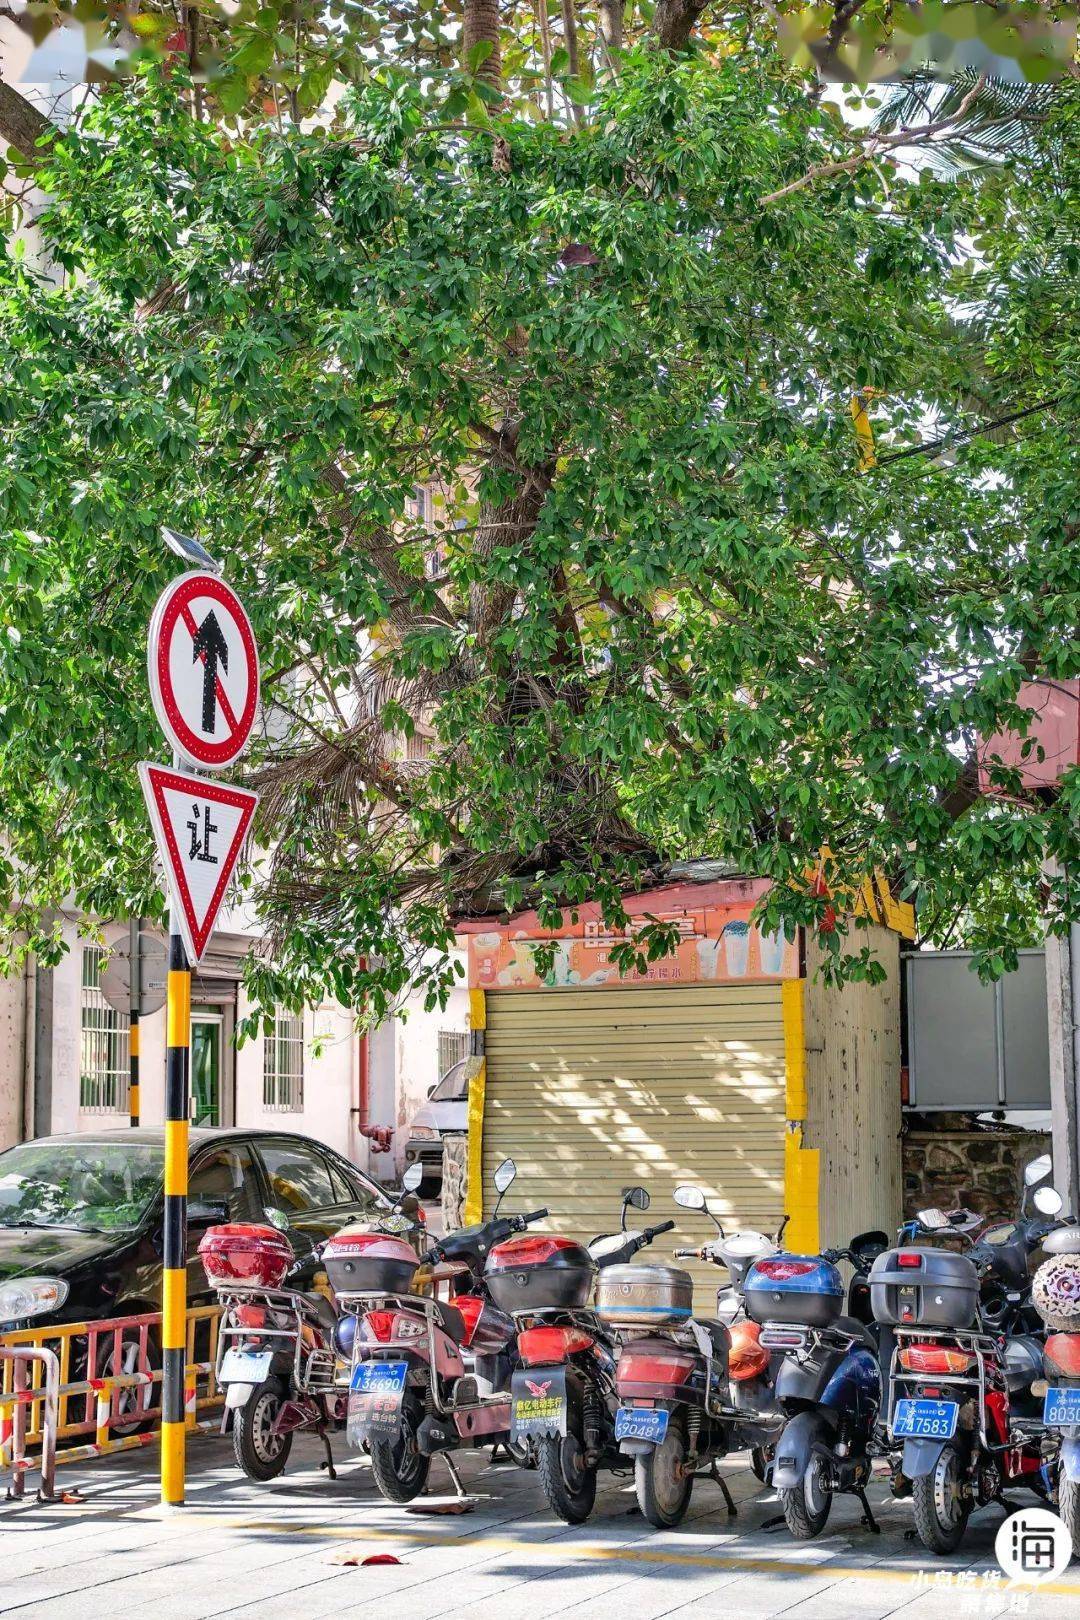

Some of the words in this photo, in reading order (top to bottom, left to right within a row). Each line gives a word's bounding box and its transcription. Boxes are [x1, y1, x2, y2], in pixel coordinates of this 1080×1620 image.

[187, 803, 218, 864] 让
[356, 1376, 400, 1391] 136690
[617, 1422, 660, 1437] 590481
[897, 1417, 949, 1435] 747583
